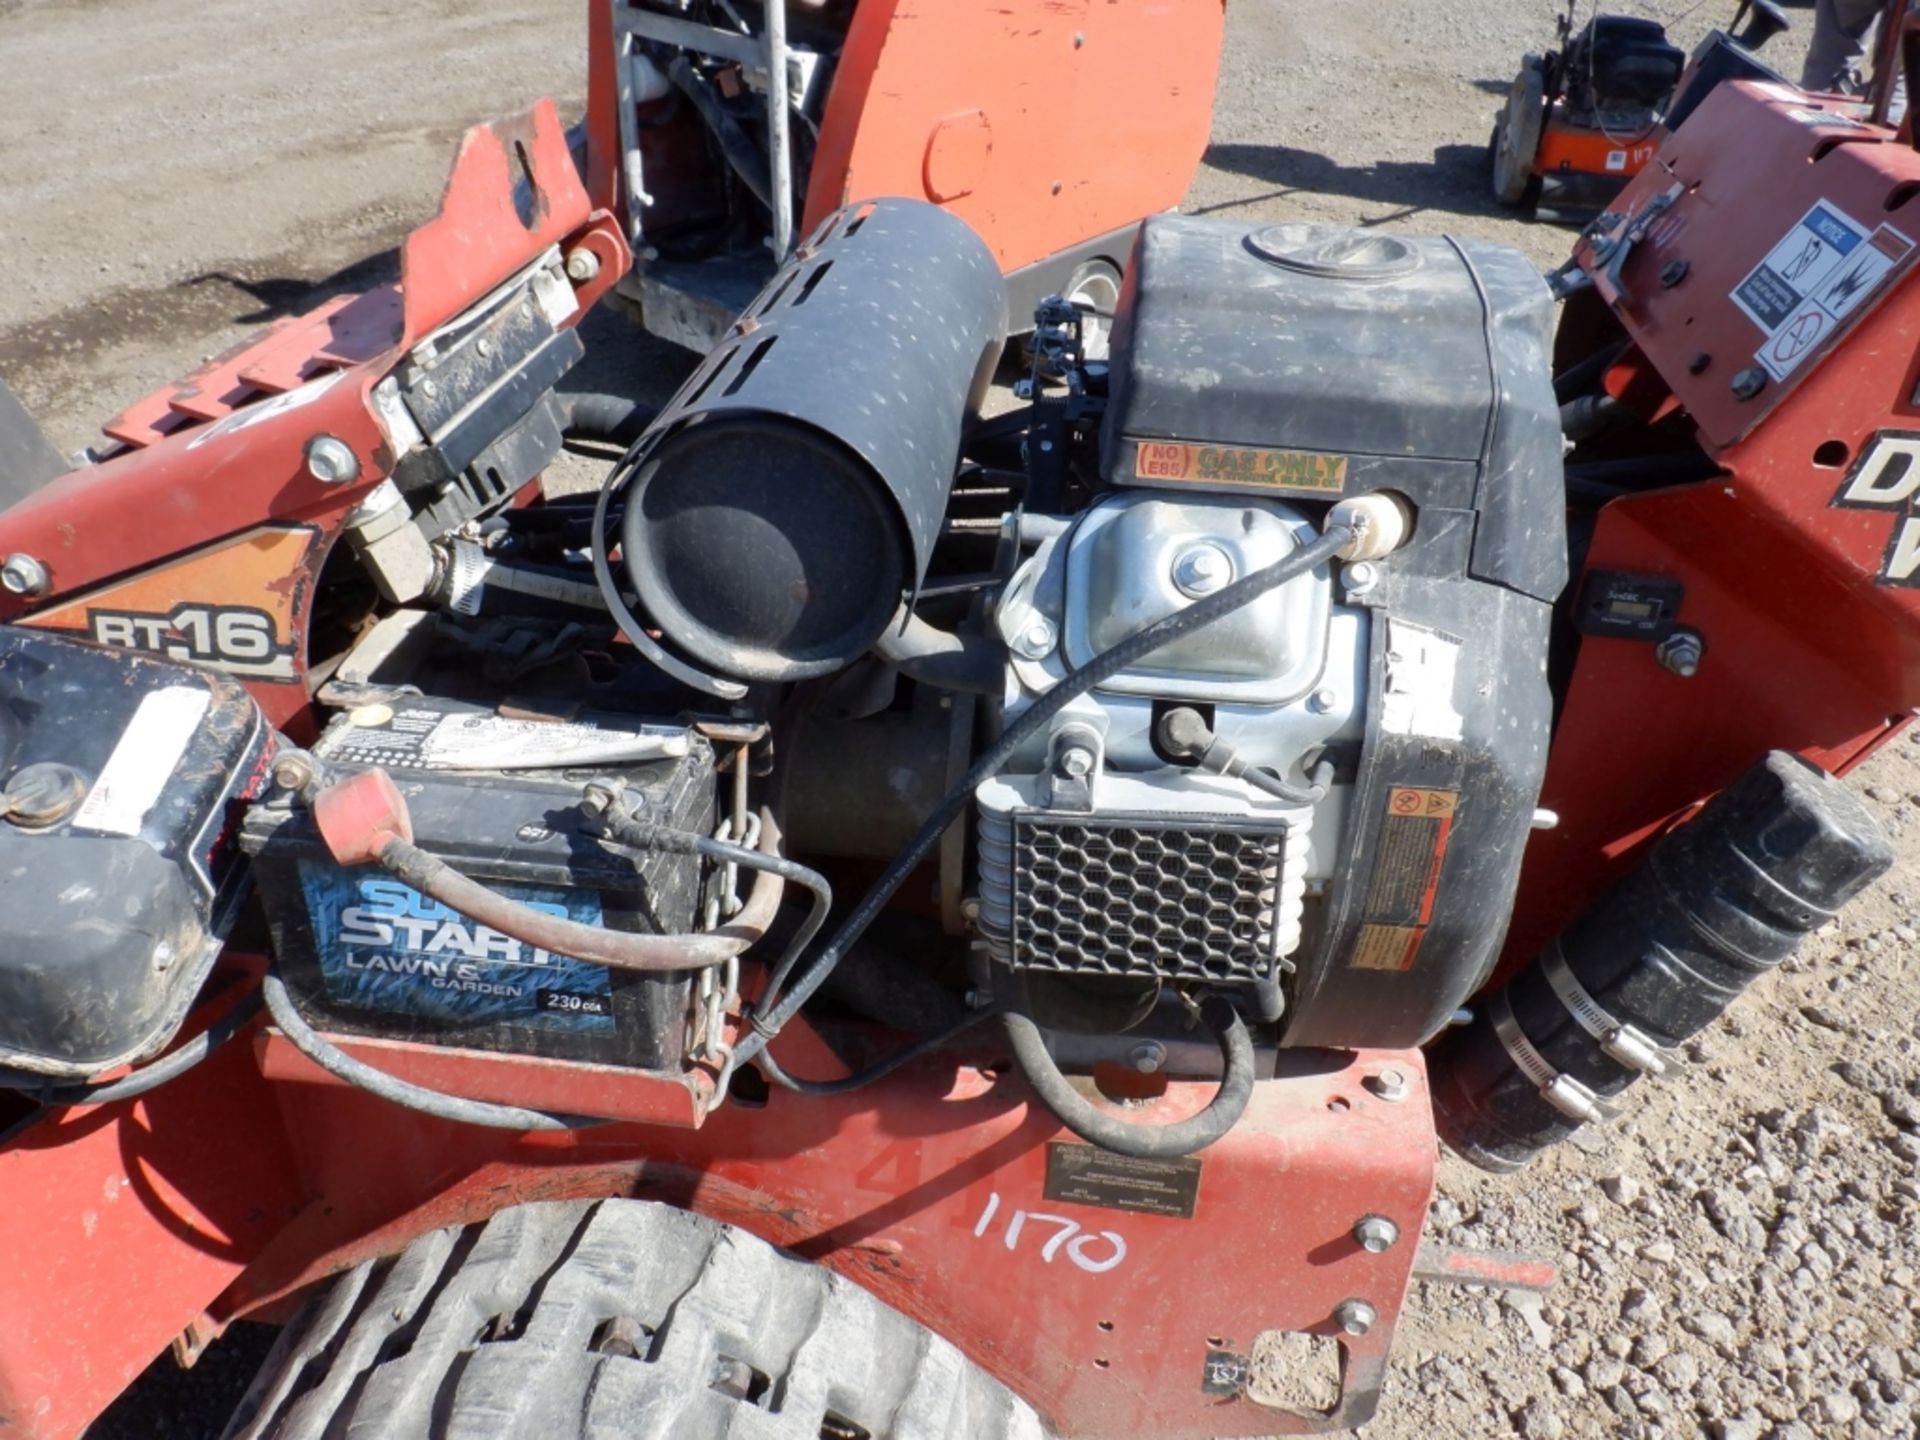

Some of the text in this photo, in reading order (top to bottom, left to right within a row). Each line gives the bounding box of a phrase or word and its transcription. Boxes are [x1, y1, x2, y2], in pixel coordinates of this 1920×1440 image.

[1152, 445, 1178, 460] NO
[1147, 460, 1181, 477] E85
[1197, 447, 1257, 472] GAS
[1265, 452, 1343, 479] ONLY
[346, 951, 482, 982] LAWN &
[431, 976, 524, 998] GARDEN
[547, 993, 582, 1011] 230
